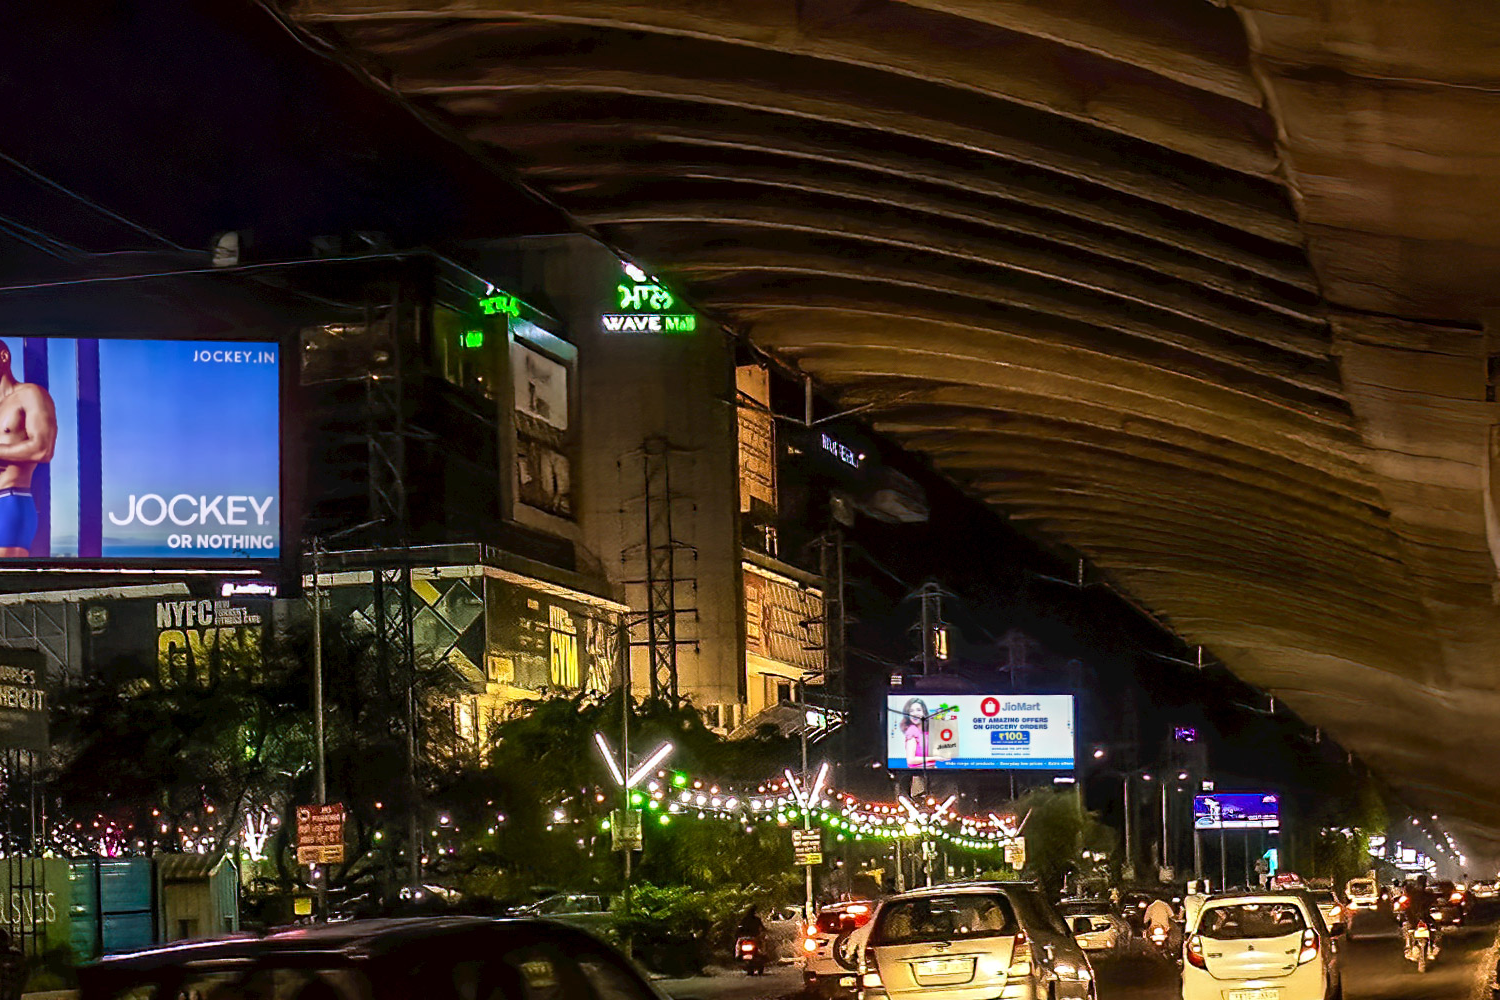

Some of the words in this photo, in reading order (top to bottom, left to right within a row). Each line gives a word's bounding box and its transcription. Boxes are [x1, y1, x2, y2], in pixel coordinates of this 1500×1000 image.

[602, 316, 662, 332] WAVE
[193, 350, 275, 364] JOCKEY.IN
[108, 493, 274, 526] JOCKEY
[167, 534, 193, 548] OR
[196, 535, 274, 549] NOTHING
[156, 599, 213, 628] NYFC
[1001, 702, 1041, 712] JioMart
